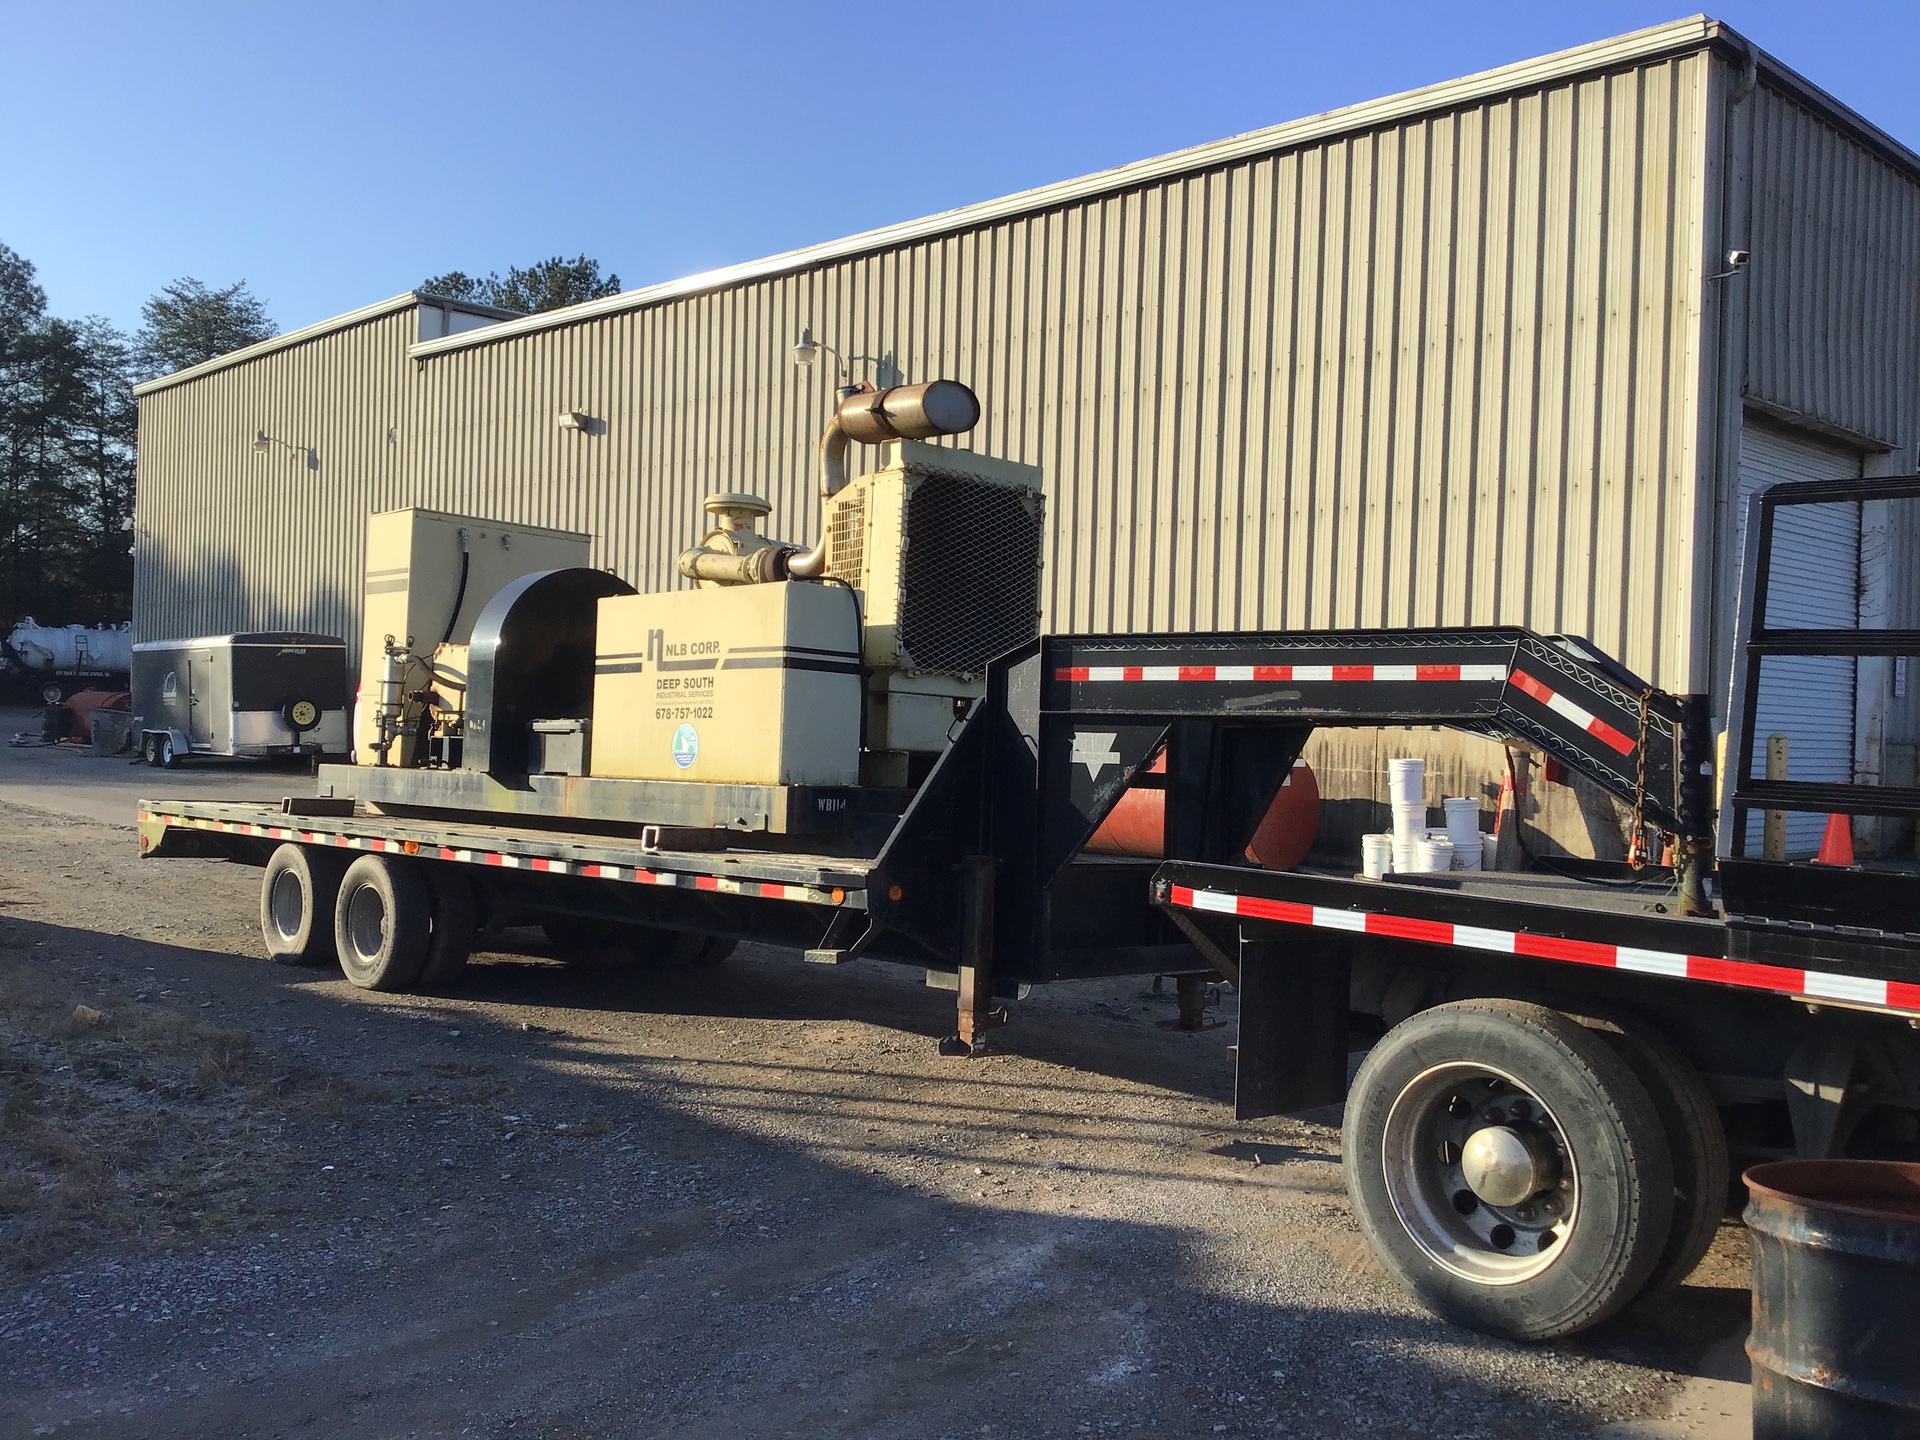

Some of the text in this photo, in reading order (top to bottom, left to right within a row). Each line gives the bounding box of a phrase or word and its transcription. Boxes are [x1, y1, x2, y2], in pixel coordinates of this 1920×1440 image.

[666, 640, 720, 657] NLB CORP.
[656, 676, 714, 690] DEEP SOUTH
[656, 689, 714, 699] INDUSTRIAL SERVICES
[655, 706, 713, 719] 678-757-1022
